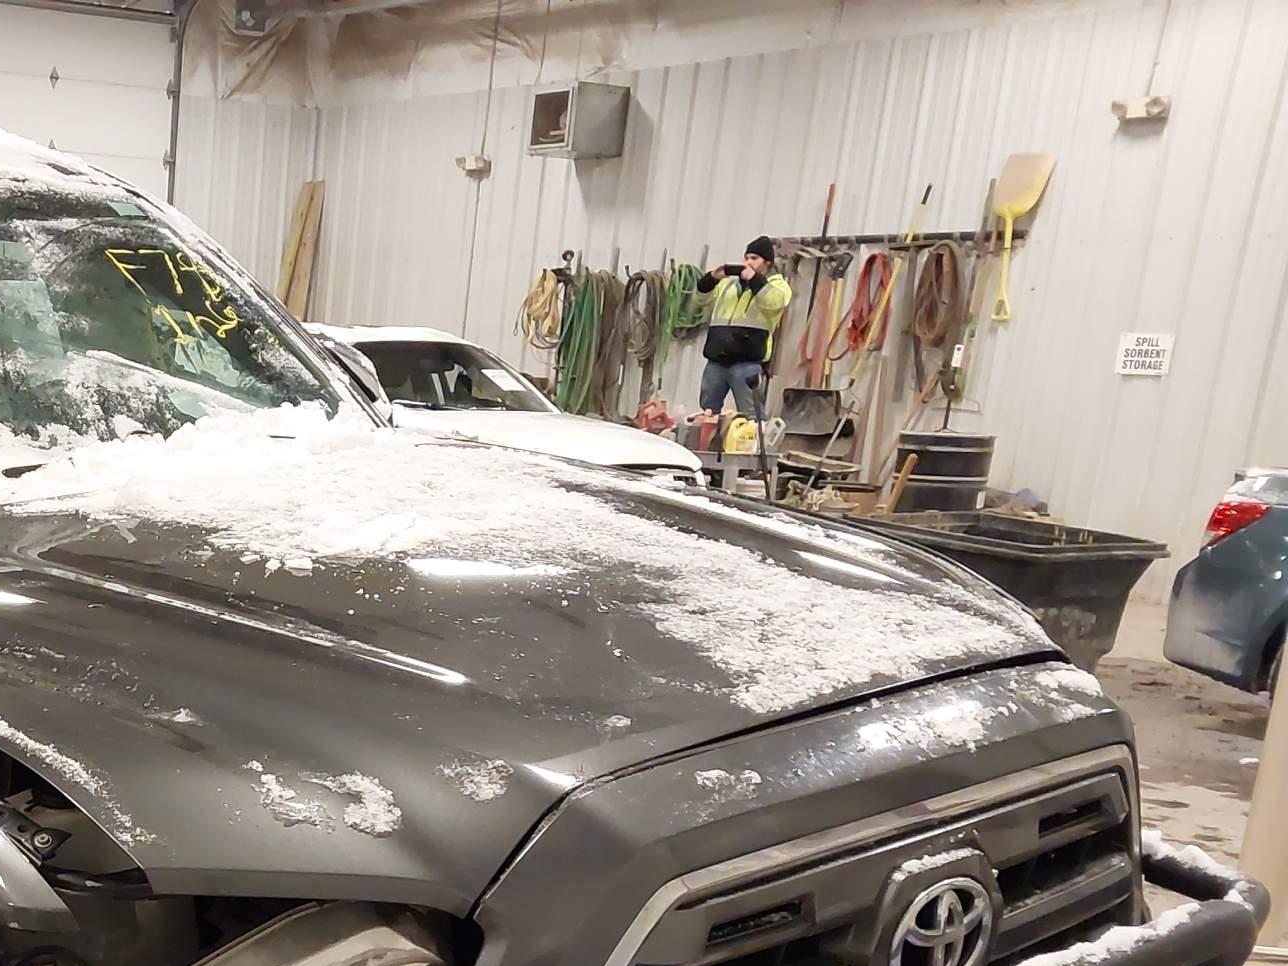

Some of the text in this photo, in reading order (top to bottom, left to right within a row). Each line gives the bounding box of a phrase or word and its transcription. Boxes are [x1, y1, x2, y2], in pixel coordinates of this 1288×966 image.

[1135, 336, 1160, 347] SPILL
[1123, 347, 1167, 359] SORBENT
[1121, 359, 1164, 370] STORAGE
